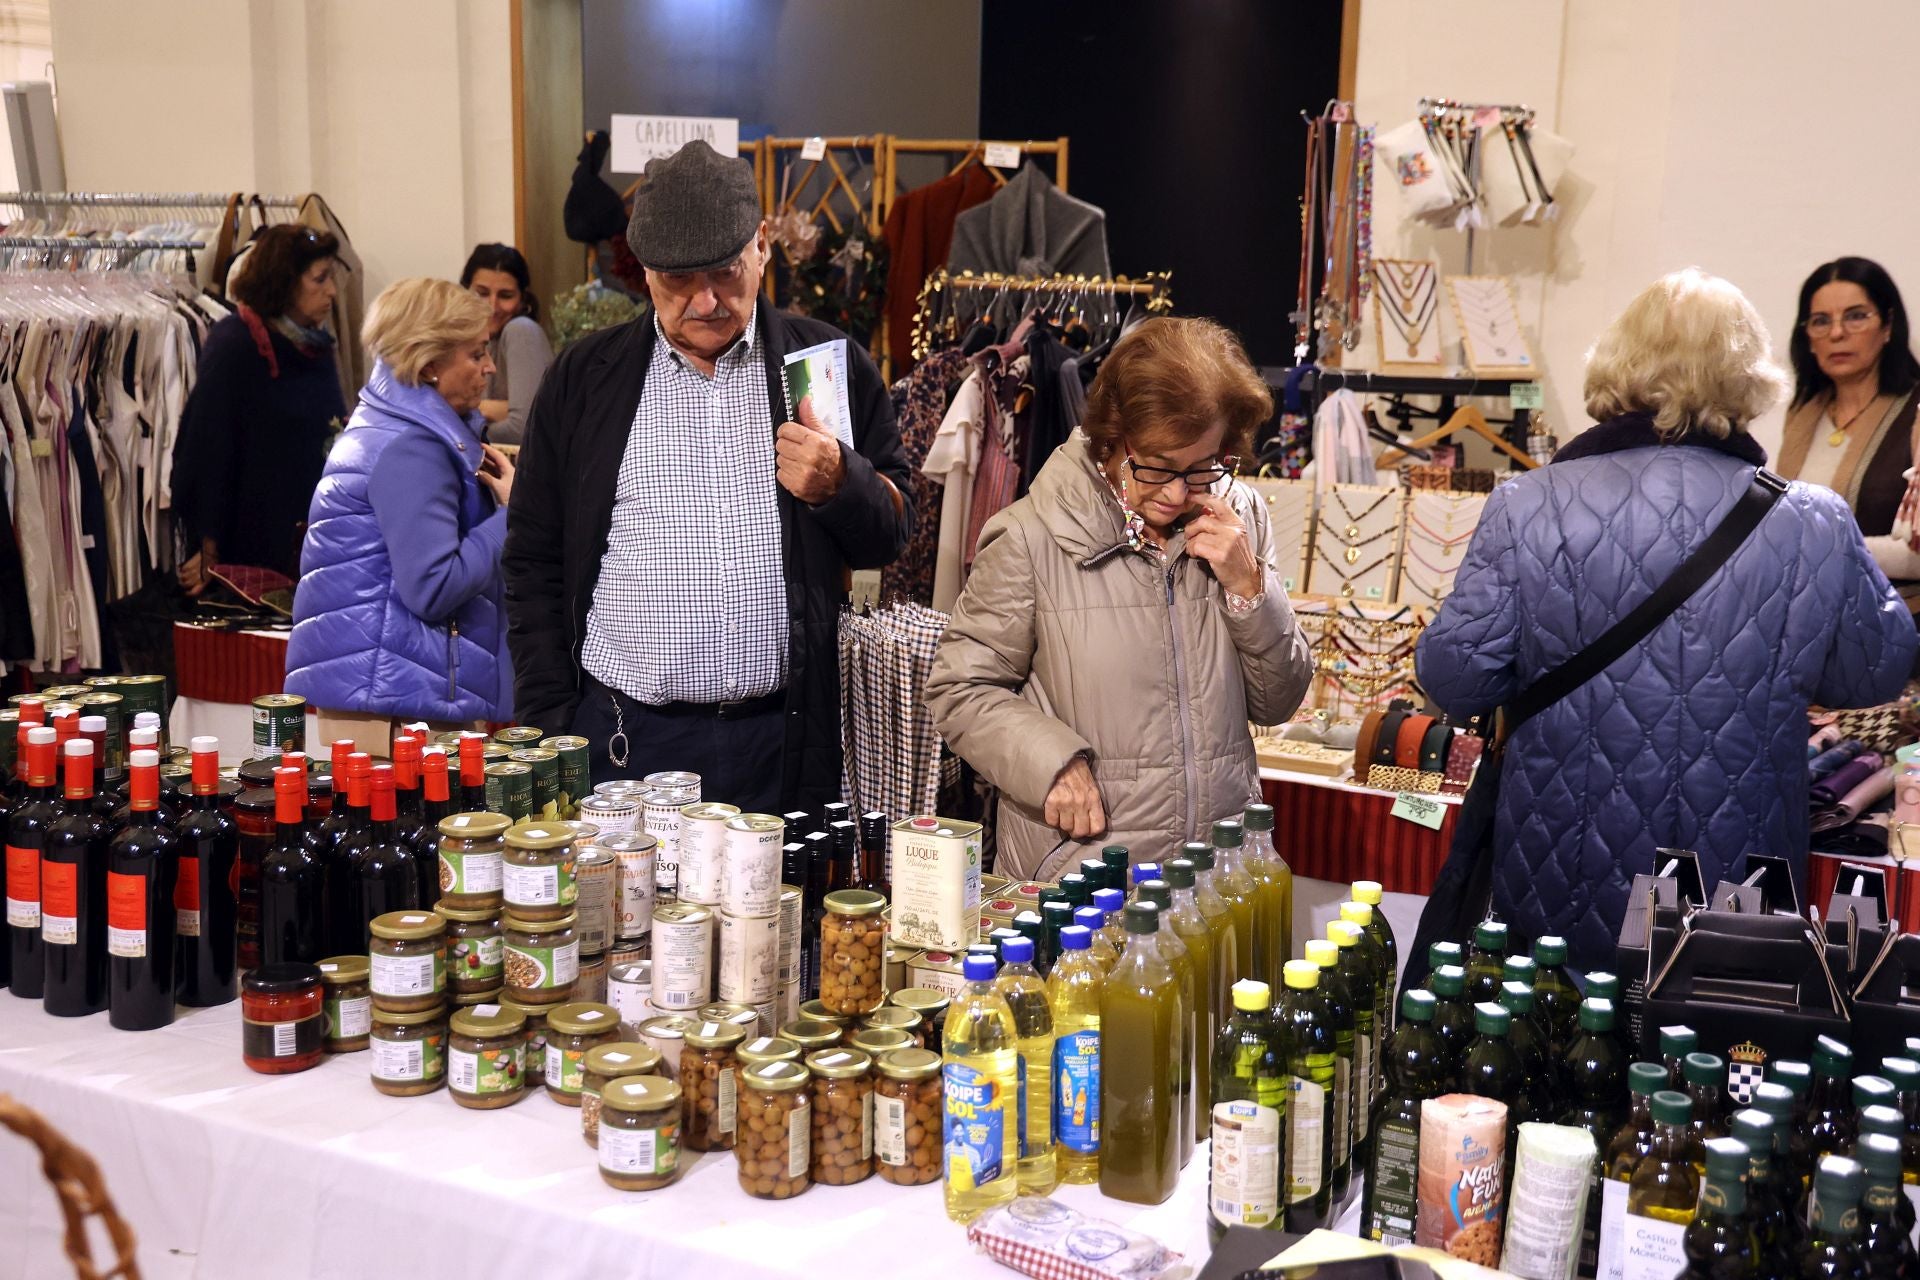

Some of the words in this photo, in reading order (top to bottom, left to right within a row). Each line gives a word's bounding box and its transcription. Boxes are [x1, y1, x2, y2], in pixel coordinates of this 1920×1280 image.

[906, 846, 939, 860] LUQUE
[1075, 1037, 1099, 1048] KOIPE
[1078, 1046, 1097, 1055] SOL
[944, 1076, 983, 1102] KOIPE
[946, 1096, 978, 1119] SOL
[1456, 1145, 1489, 1161] Family
[1636, 1229, 1678, 1247] CASTILLO
[1629, 1246, 1681, 1264] MONCLOVA
